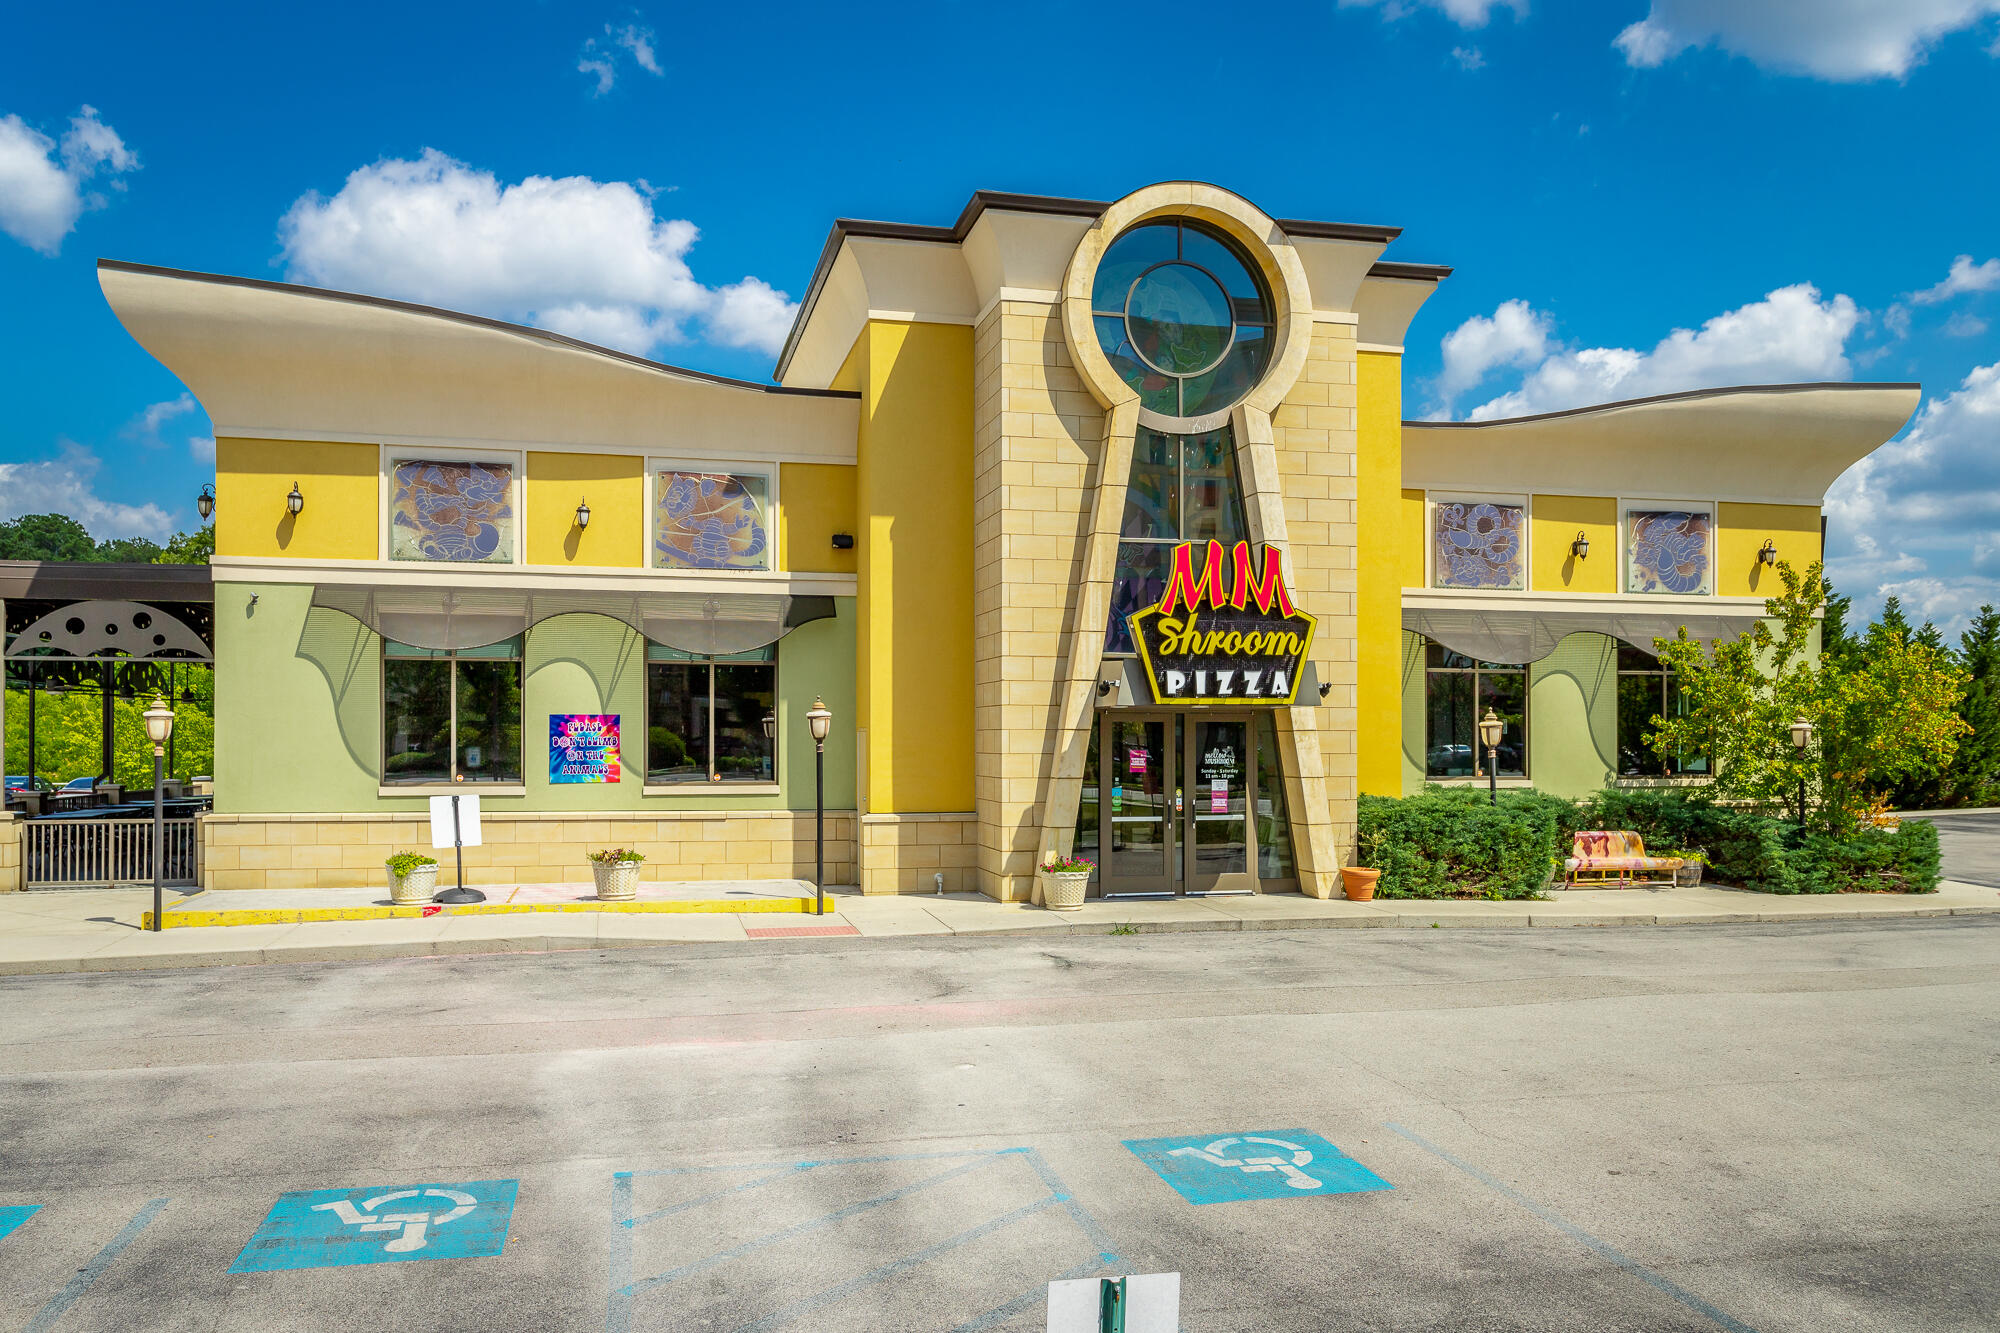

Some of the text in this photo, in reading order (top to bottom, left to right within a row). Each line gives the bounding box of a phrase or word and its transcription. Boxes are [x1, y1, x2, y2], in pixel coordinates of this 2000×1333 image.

[1157, 612, 1304, 656] Shroom
[1166, 670, 1289, 695] PIZZA
[567, 722, 603, 732] PLEASE
[552, 736, 618, 747] DON'T CLIMB
[566, 750, 604, 761] ON THE
[562, 764, 610, 775] ANIMALS
